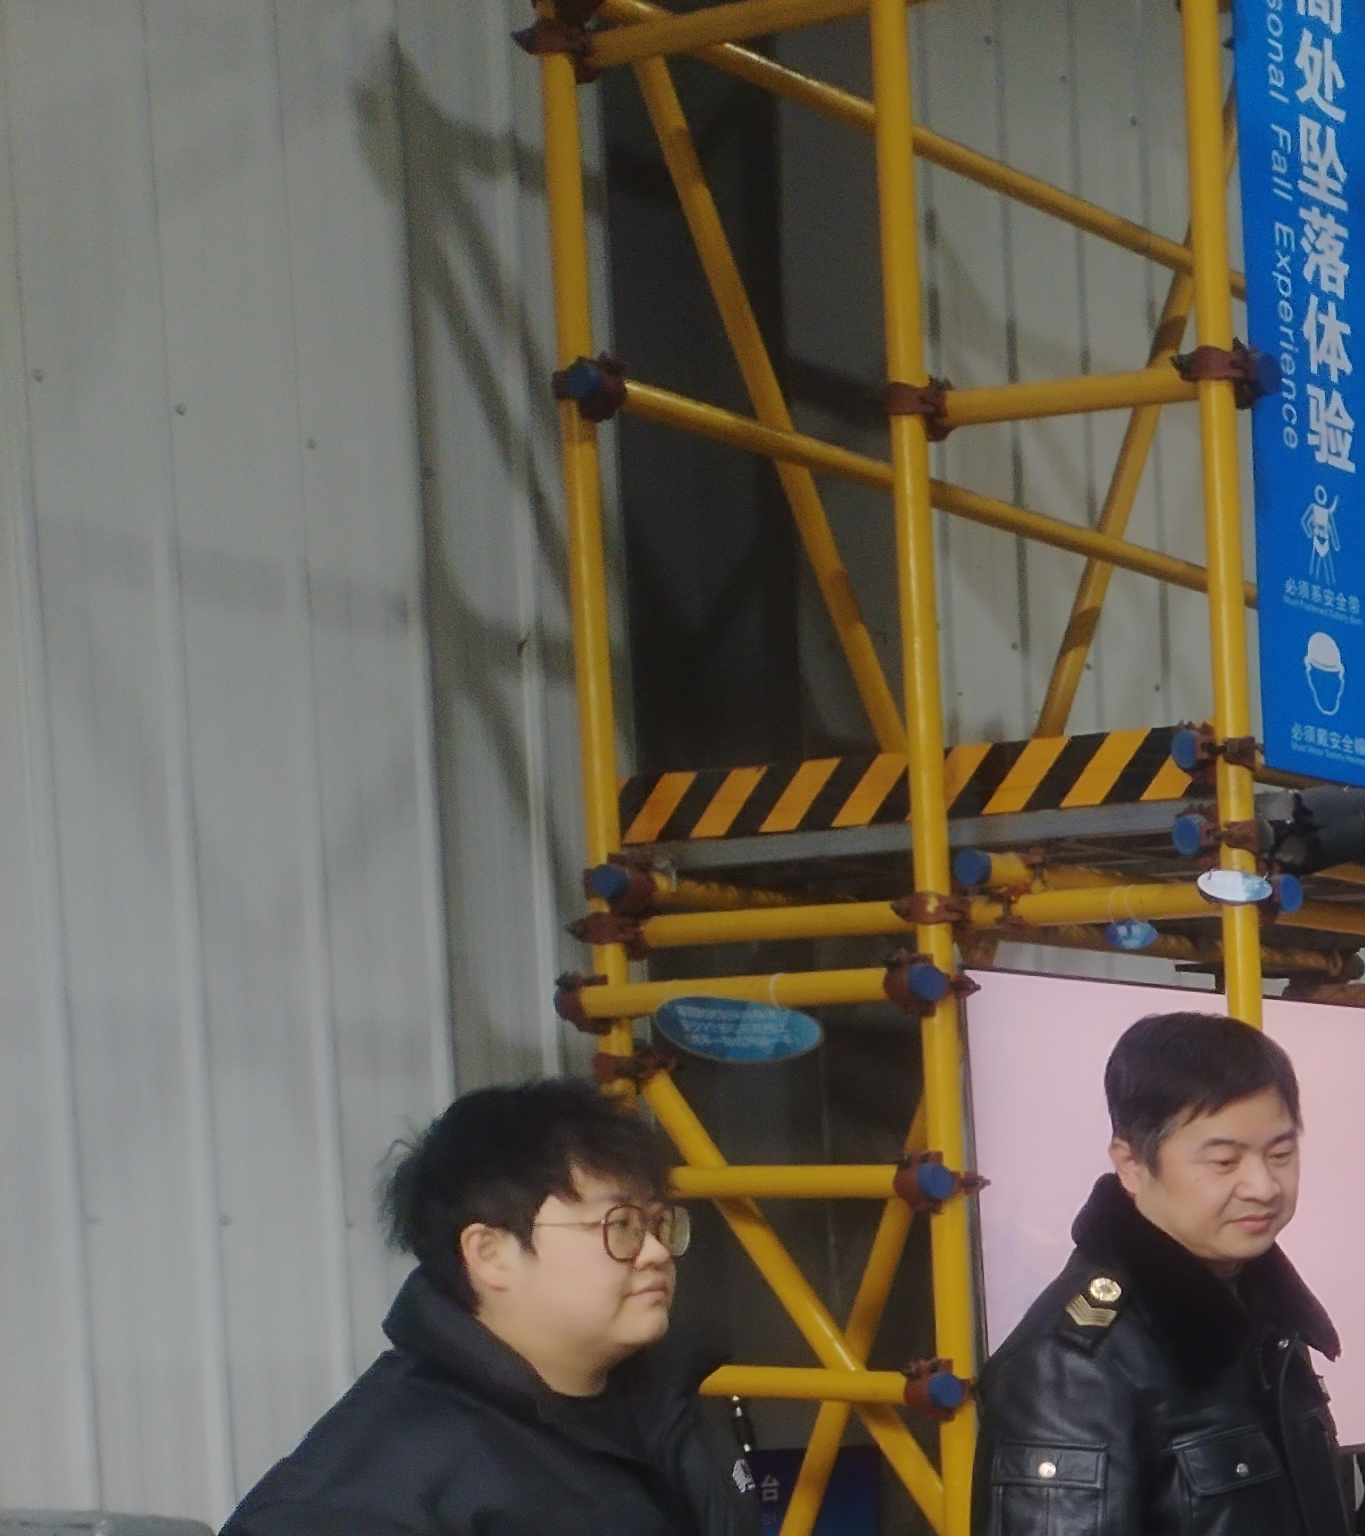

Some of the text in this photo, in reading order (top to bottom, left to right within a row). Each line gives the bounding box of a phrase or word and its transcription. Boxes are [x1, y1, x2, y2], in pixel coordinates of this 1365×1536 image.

[1266, 0, 1299, 449] sonal Fall Experience
